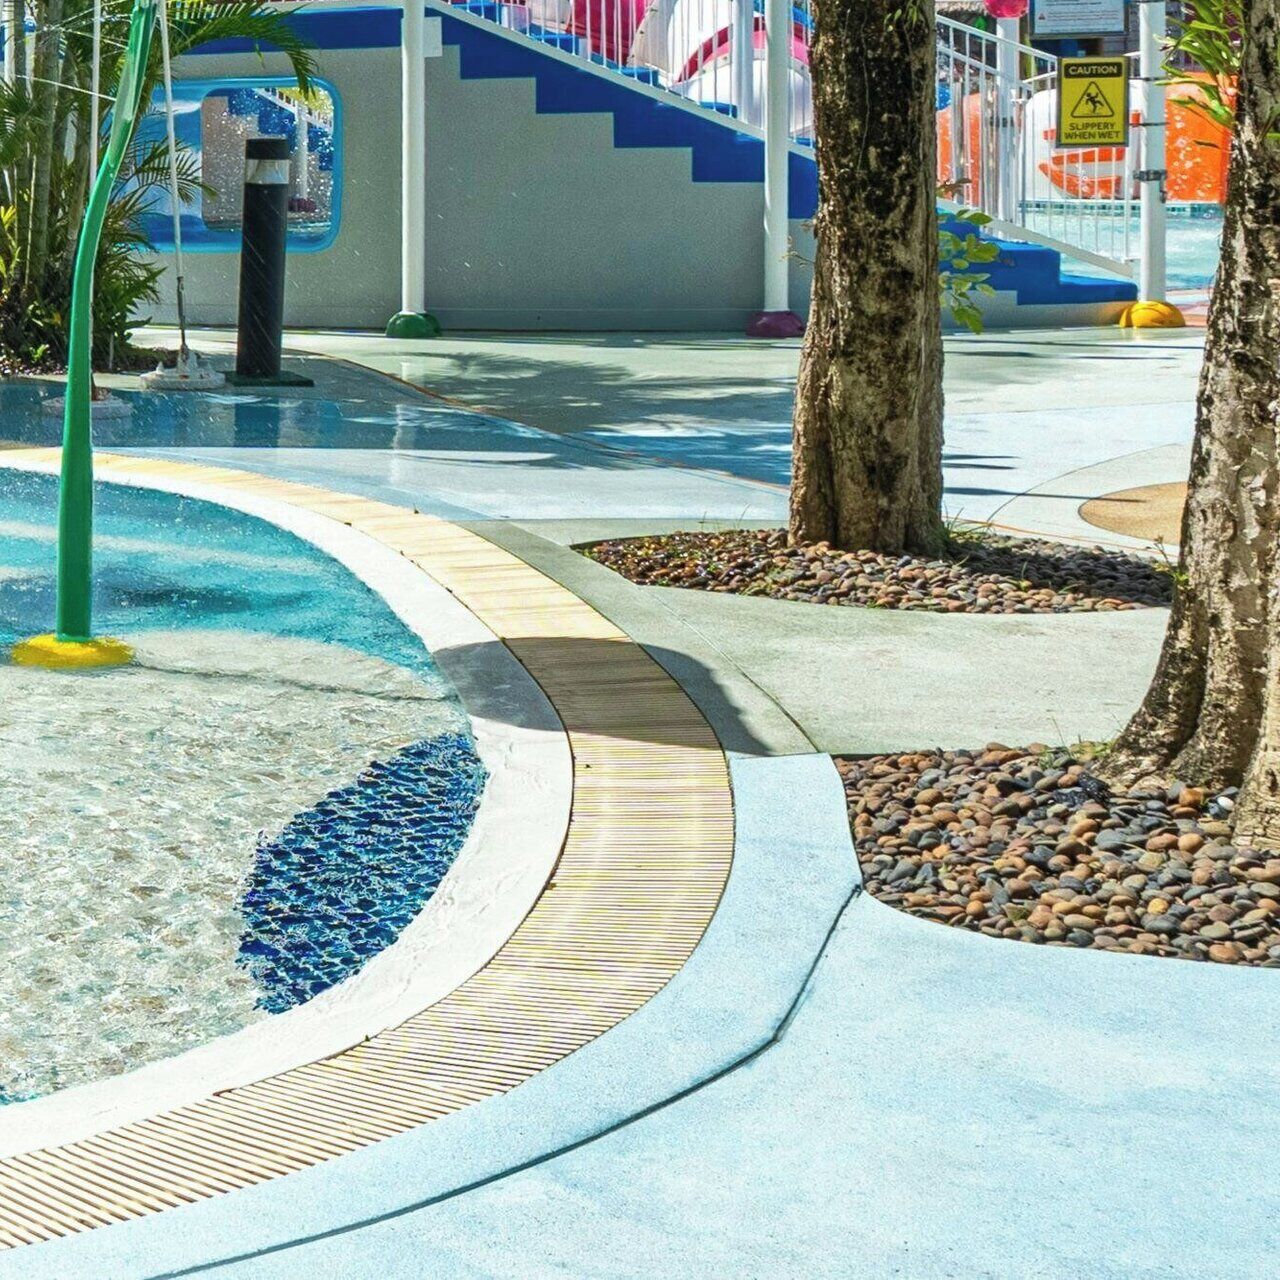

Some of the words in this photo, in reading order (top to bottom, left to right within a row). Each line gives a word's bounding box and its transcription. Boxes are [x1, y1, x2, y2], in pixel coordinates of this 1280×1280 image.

[1069, 66, 1117, 75] CAUTION
[1069, 122, 1115, 131] SLIPPERY
[1064, 131, 1096, 140] WHEN
[1097, 131, 1121, 139] WET
